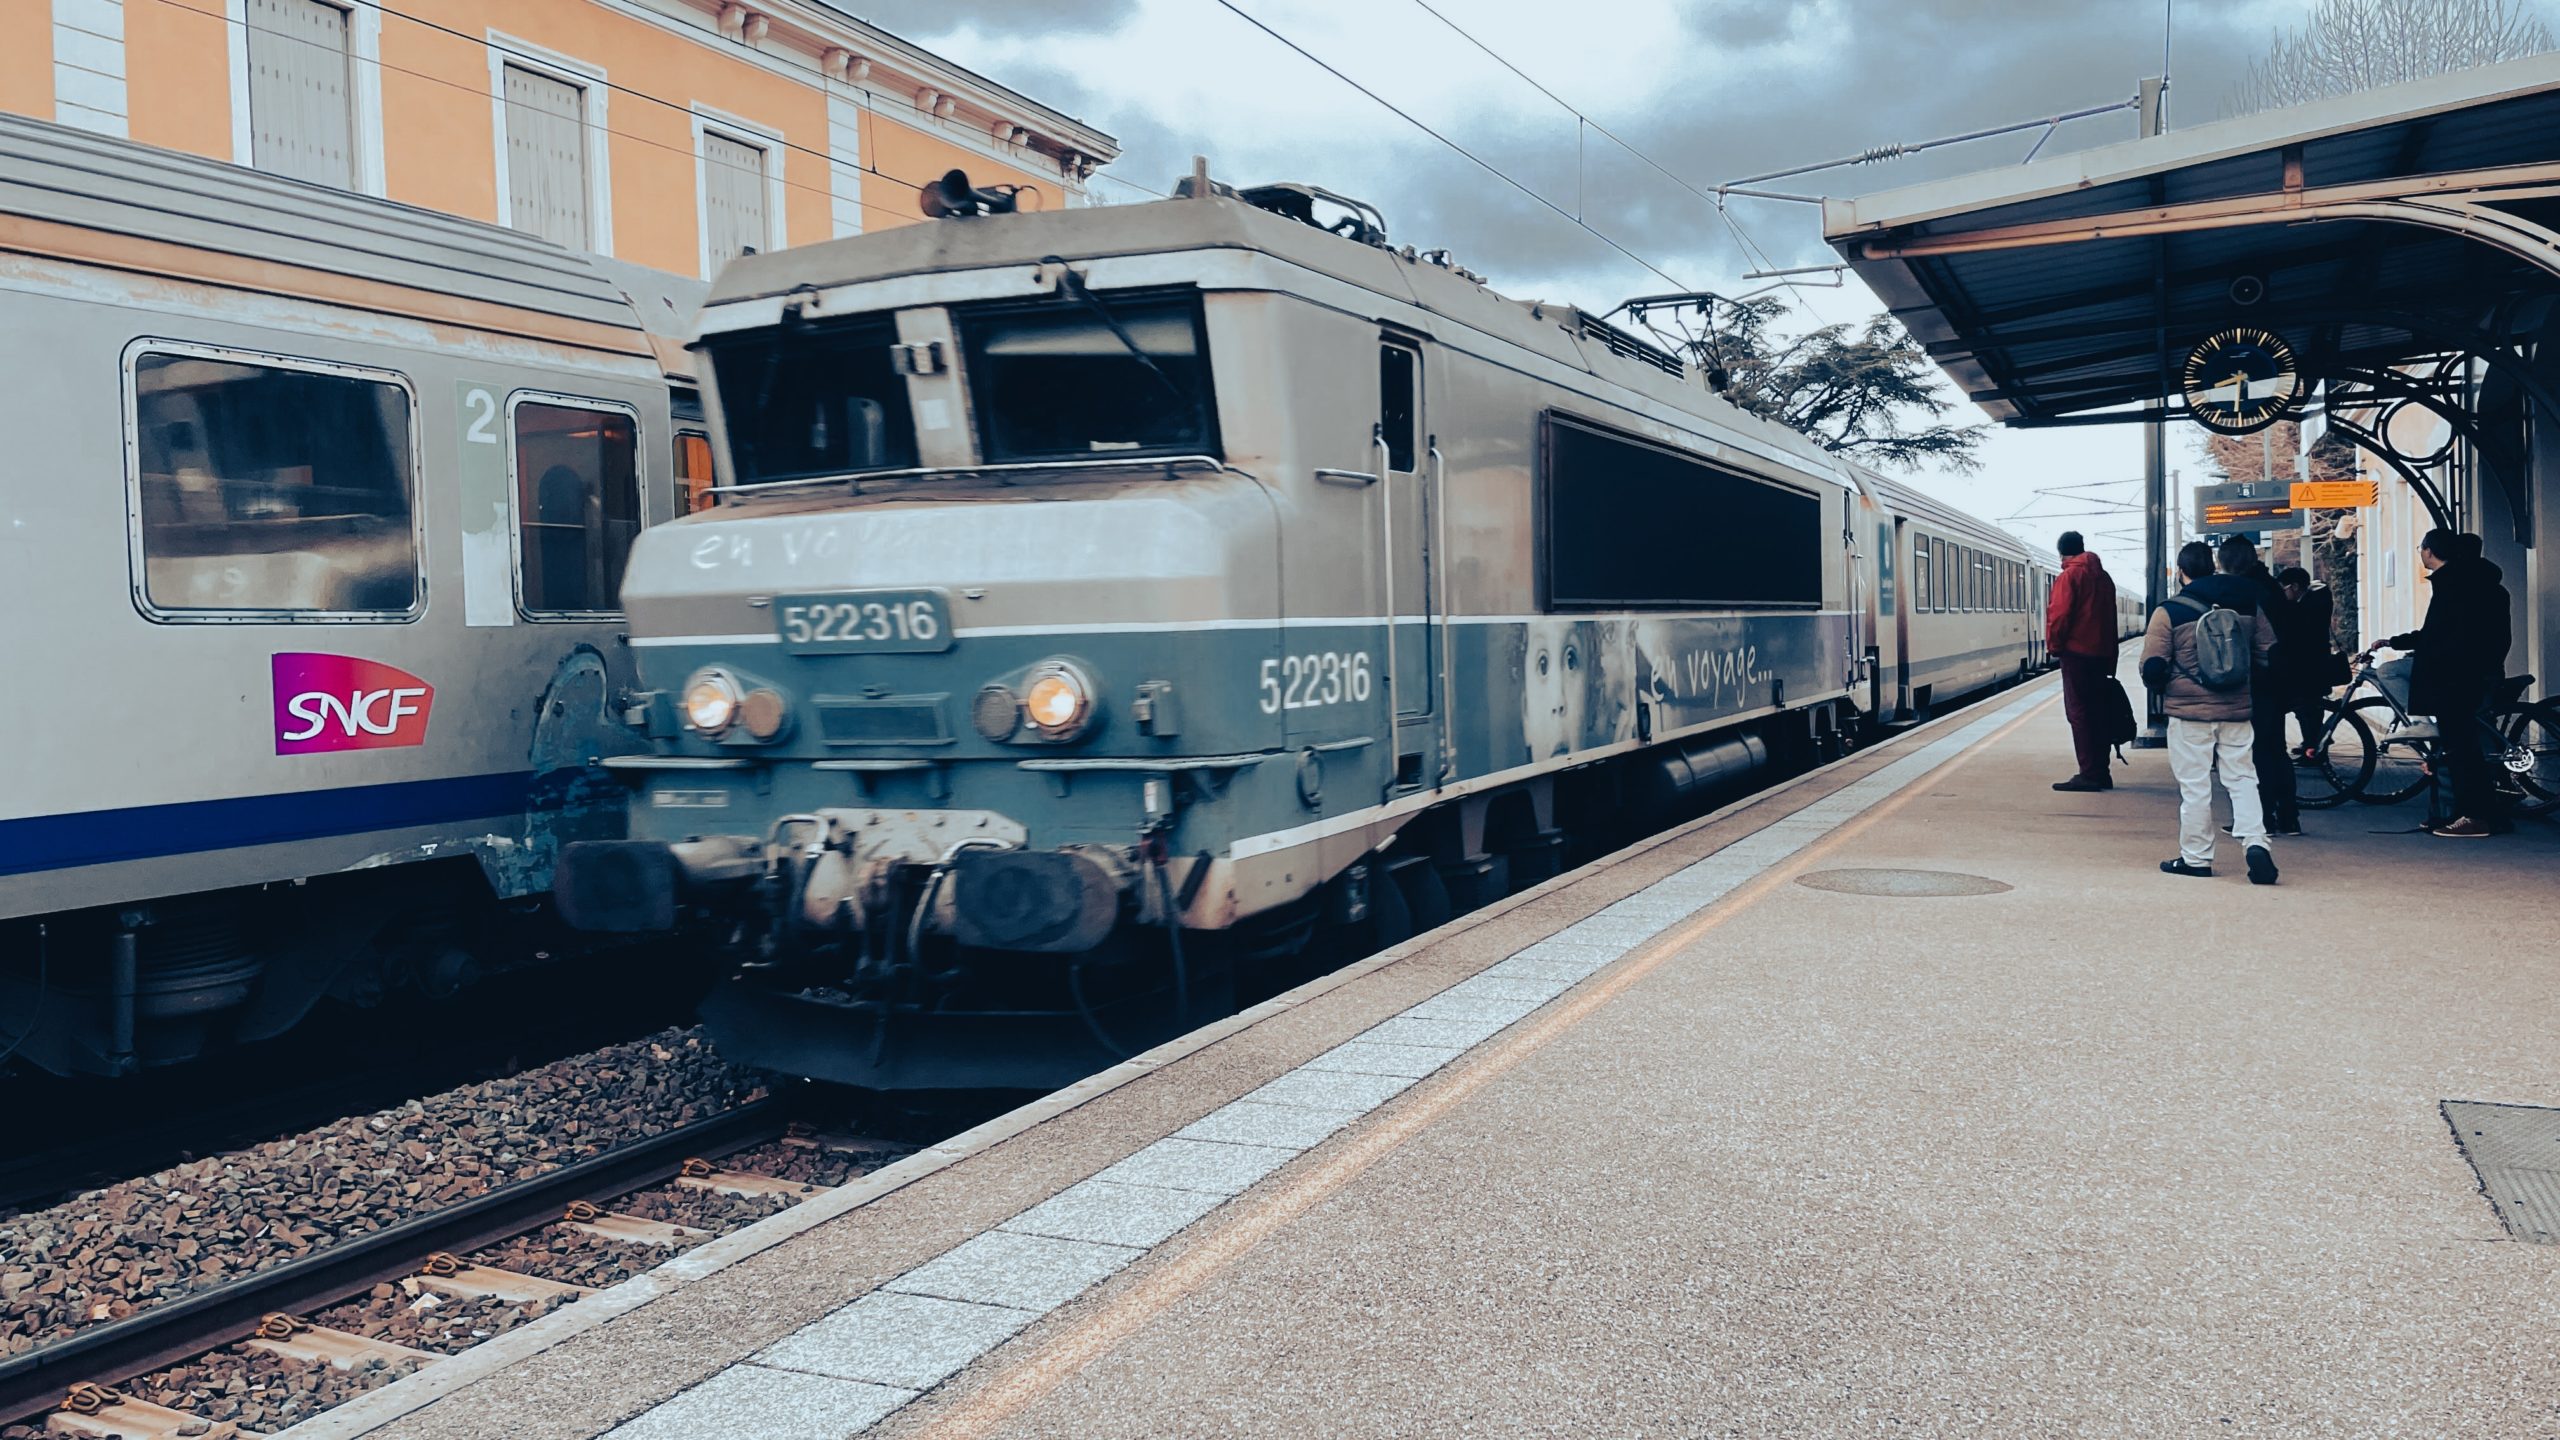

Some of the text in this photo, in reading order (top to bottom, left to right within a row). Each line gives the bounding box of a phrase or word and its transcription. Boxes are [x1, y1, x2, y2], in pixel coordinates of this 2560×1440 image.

[465, 388, 497, 444] 2
[784, 601, 938, 643] 522316
[1260, 652, 1371, 714] 522316
[1651, 655, 1680, 702] en
[283, 688, 426, 741] SNCF
